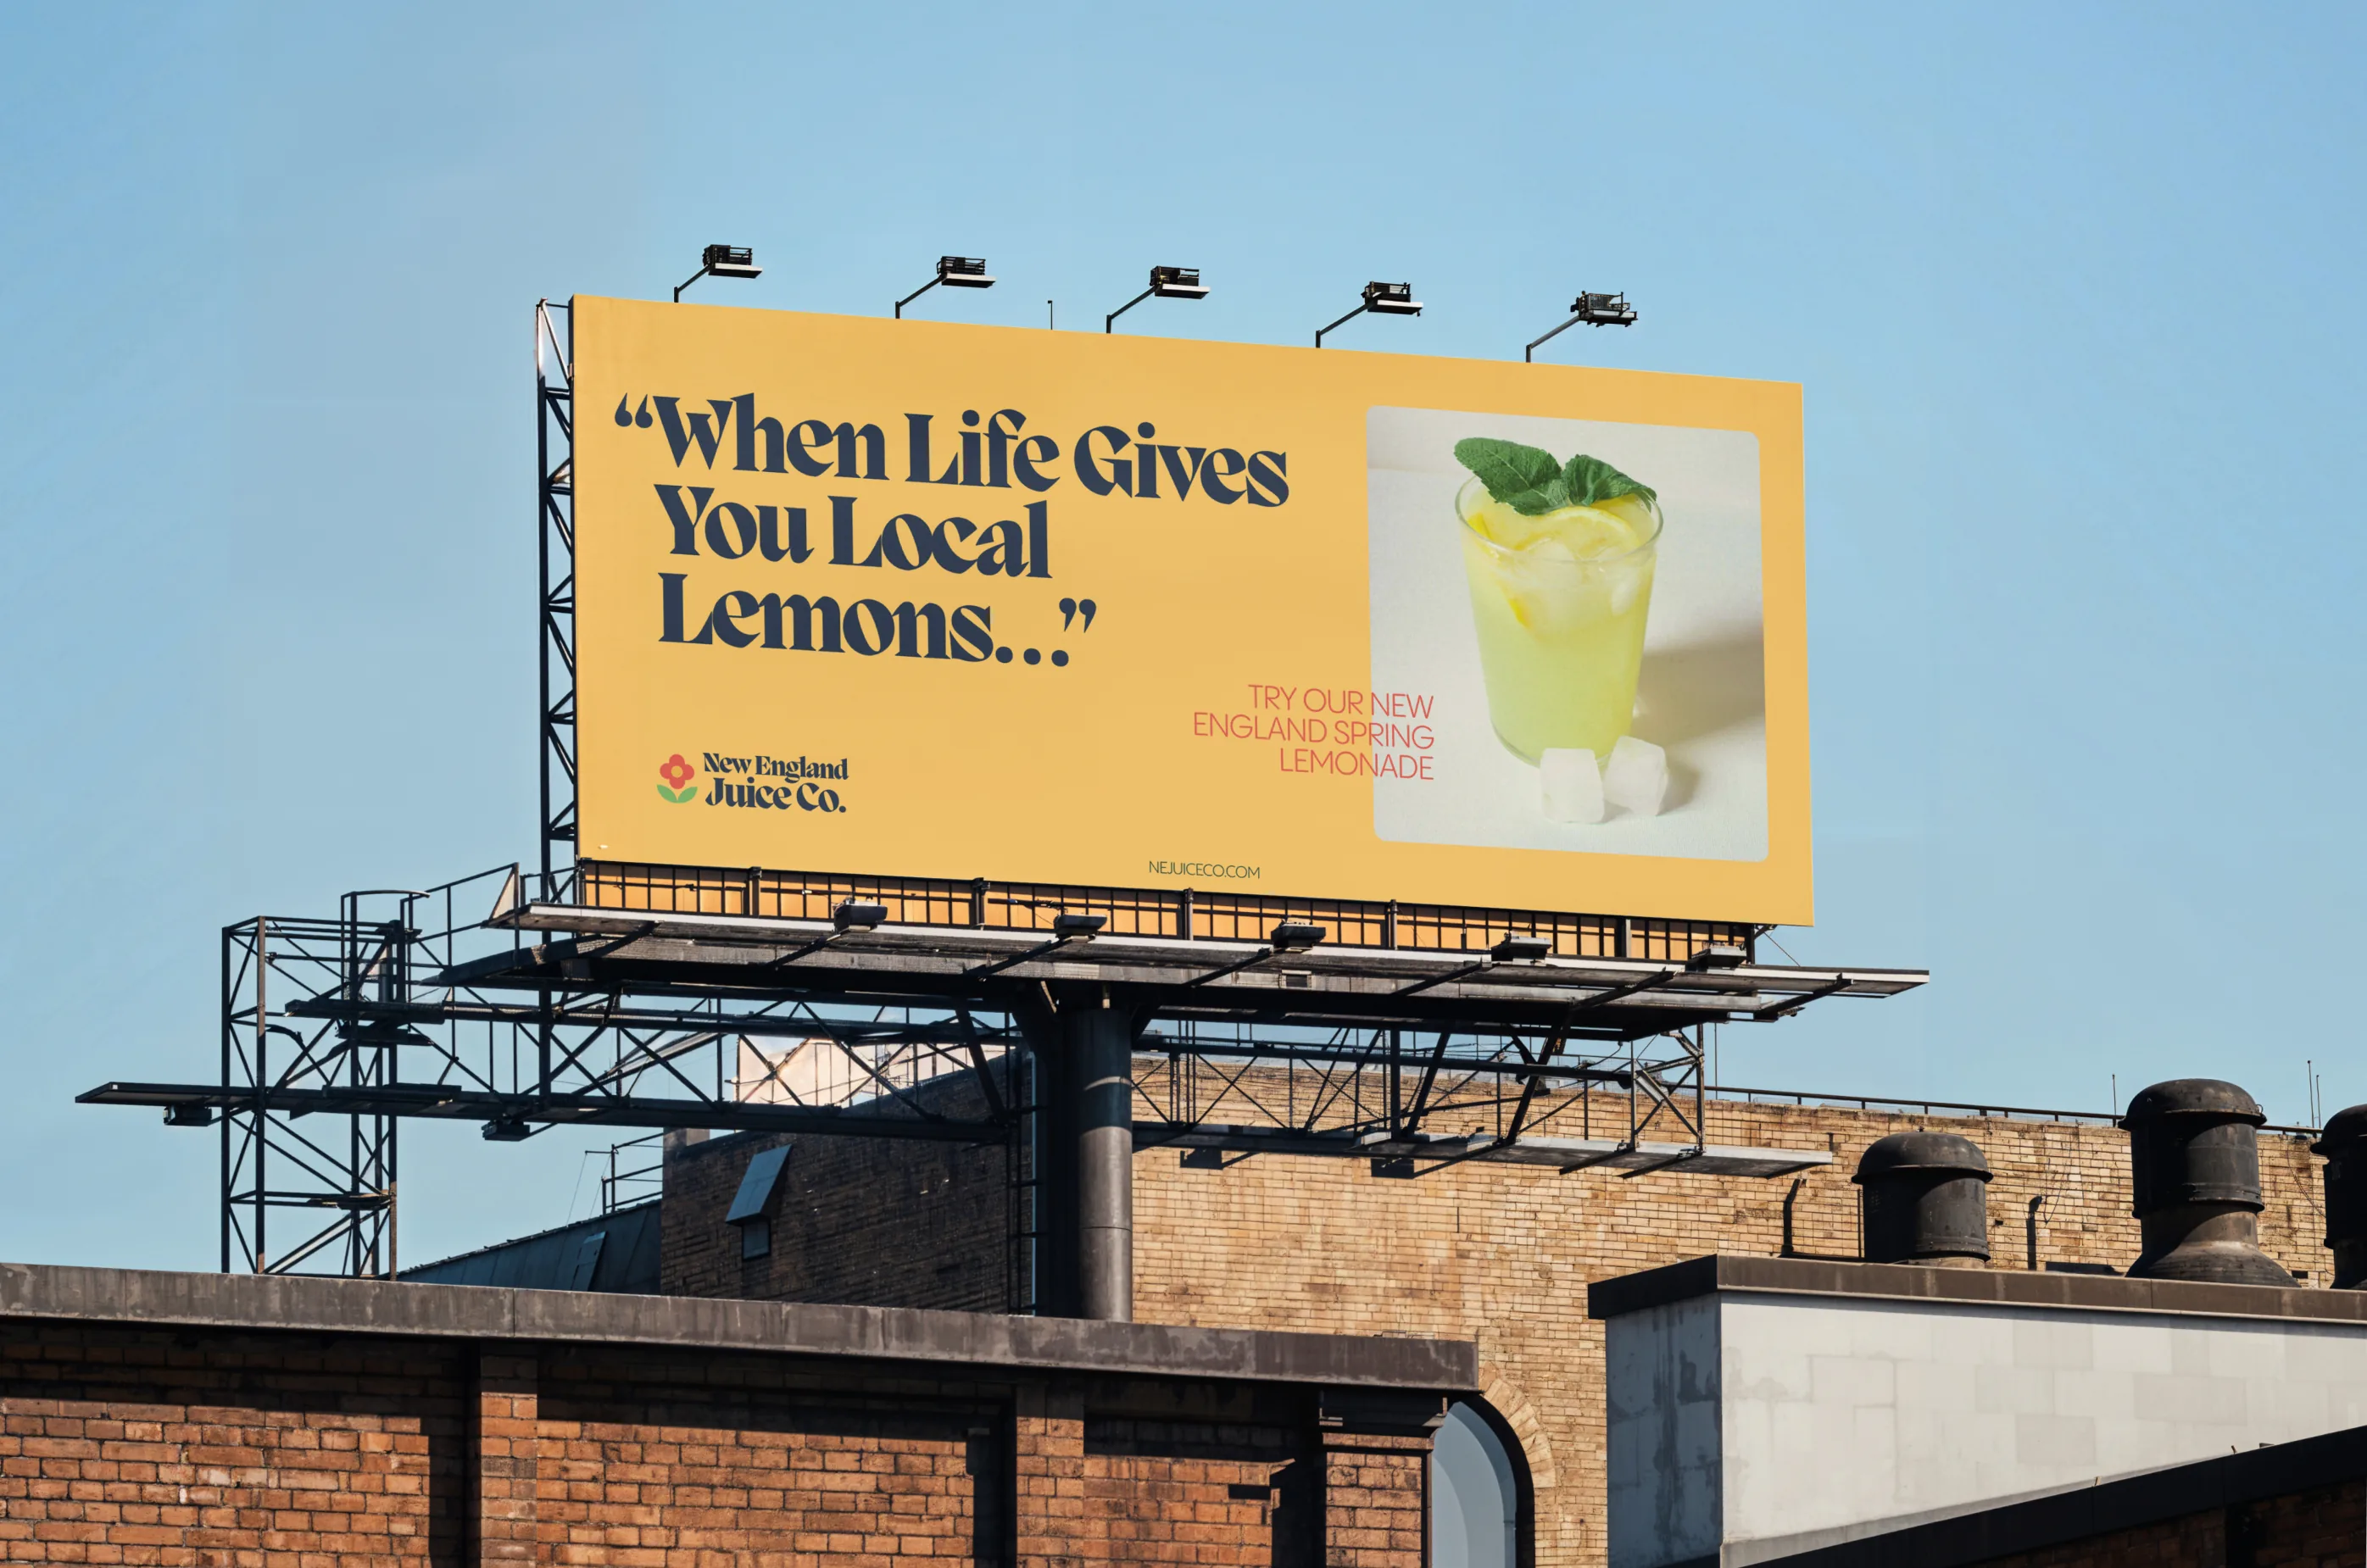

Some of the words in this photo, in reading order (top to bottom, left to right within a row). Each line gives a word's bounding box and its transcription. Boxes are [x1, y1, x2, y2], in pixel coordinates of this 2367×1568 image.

[614, 392, 890, 481] “When
[904, 409, 1061, 492] Life
[1073, 421, 1290, 508] Gives
[654, 483, 815, 564] You
[827, 495, 1053, 579] Local
[1247, 683, 1298, 711] TRY
[1302, 687, 1364, 715] OUR
[1370, 692, 1434, 720] NEW
[1194, 711, 1328, 743] ENGLAND
[1334, 720, 1434, 750] SPRING
[702, 752, 753, 775] New
[755, 755, 849, 784] England
[1280, 747, 1434, 781] LEMONADE
[705, 776, 793, 810] Juice
[795, 781, 847, 814] Co.
[1148, 859, 1261, 880] NEJUICECO.COM
